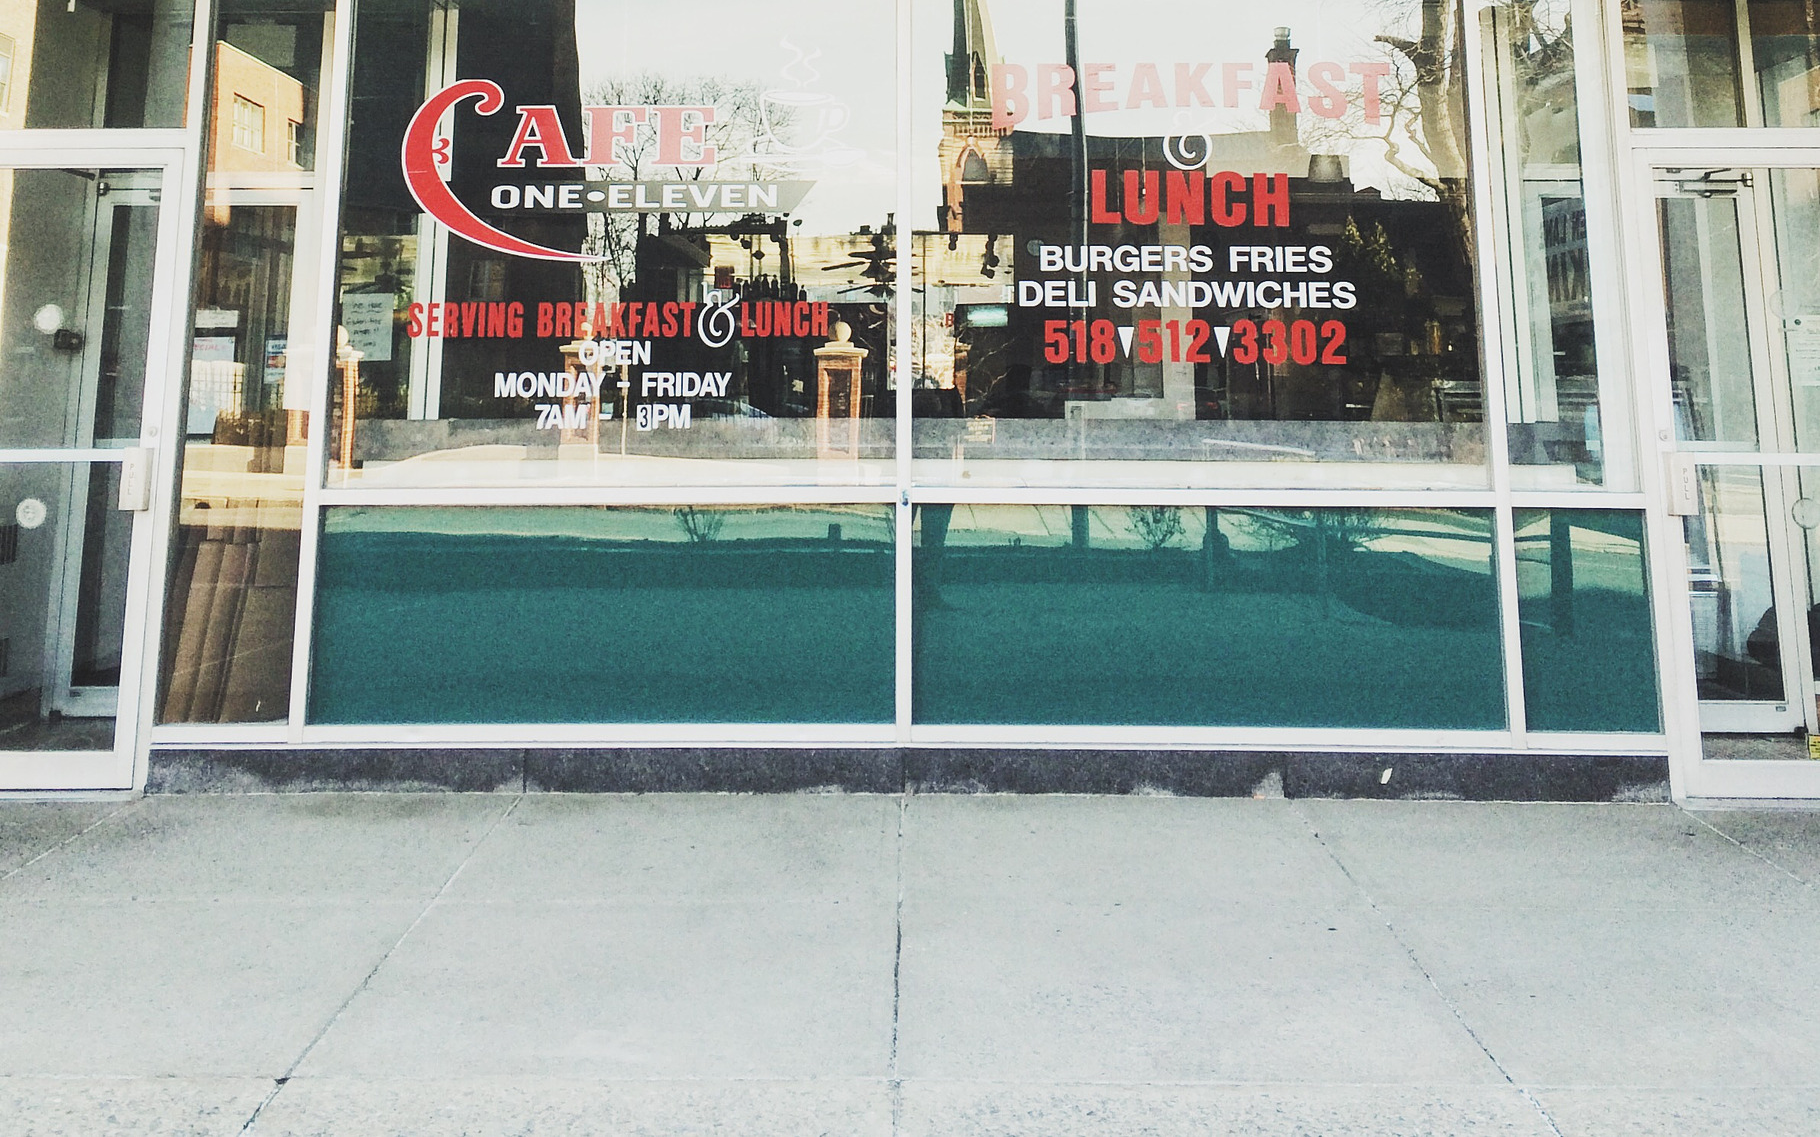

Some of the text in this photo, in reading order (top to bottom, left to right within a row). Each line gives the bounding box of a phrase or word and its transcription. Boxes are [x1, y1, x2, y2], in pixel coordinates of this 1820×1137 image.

[991, 61, 1390, 130] BREAKFAST
[402, 79, 717, 262] CAFE
[1091, 170, 1291, 228] LUNCH
[1040, 245, 1334, 274] BURGERS FRIES
[1018, 280, 1358, 310] DELI SANDWICHES
[407, 301, 524, 338] SERVING
[537, 301, 697, 338] BREAKFAST
[698, 289, 740, 348] &
[741, 301, 829, 338] LUNCH
[578, 340, 651, 365] OPEN
[1044, 319, 1348, 365] 518 512 3302
[494, 372, 606, 398] MONDAY
[641, 372, 732, 398] FRIDAY
[534, 403, 590, 431] 7AM
[636, 403, 691, 432] 3PM
[1682, 468, 1690, 500] PULL
